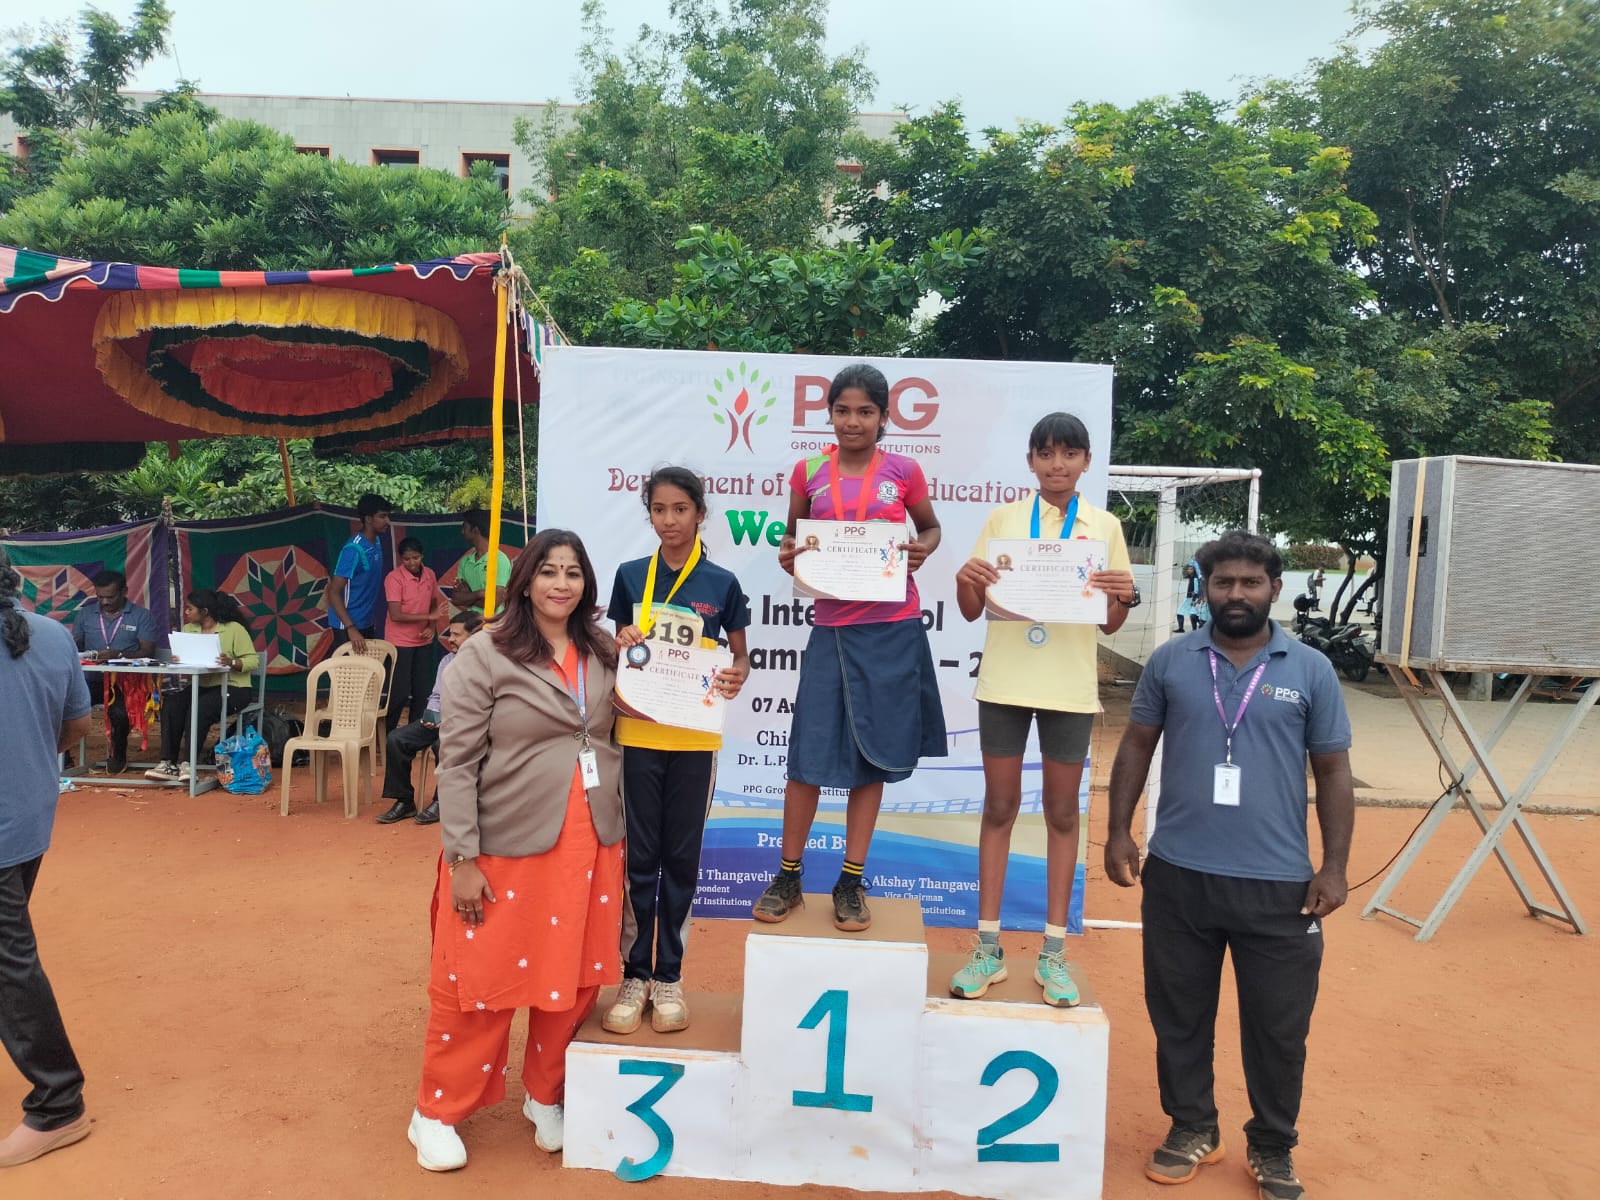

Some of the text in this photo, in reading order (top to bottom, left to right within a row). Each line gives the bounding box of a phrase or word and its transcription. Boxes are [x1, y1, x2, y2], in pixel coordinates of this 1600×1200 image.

[792, 375, 940, 431] PG
[761, 473, 785, 496] of
[927, 478, 1031, 504] ducation
[844, 526, 866, 536] PPG
[826, 545, 878, 554] CERTIFICATE
[1038, 544, 1062, 553] PPG
[668, 648, 690, 660] PPG
[1275, 687, 1300, 700] PPG
[751, 697, 773, 713] 07
[738, 754, 758, 766] Dr.
[743, 785, 763, 794] PPG
[872, 875, 916, 891] Akshay
[918, 877, 979, 893] Thangavel
[693, 897, 752, 906] of Institutions
[920, 906, 966, 916] nstitutions
[792, 990, 873, 1112] 1
[976, 1050, 1060, 1163] 2
[615, 1059, 685, 1183] 3
